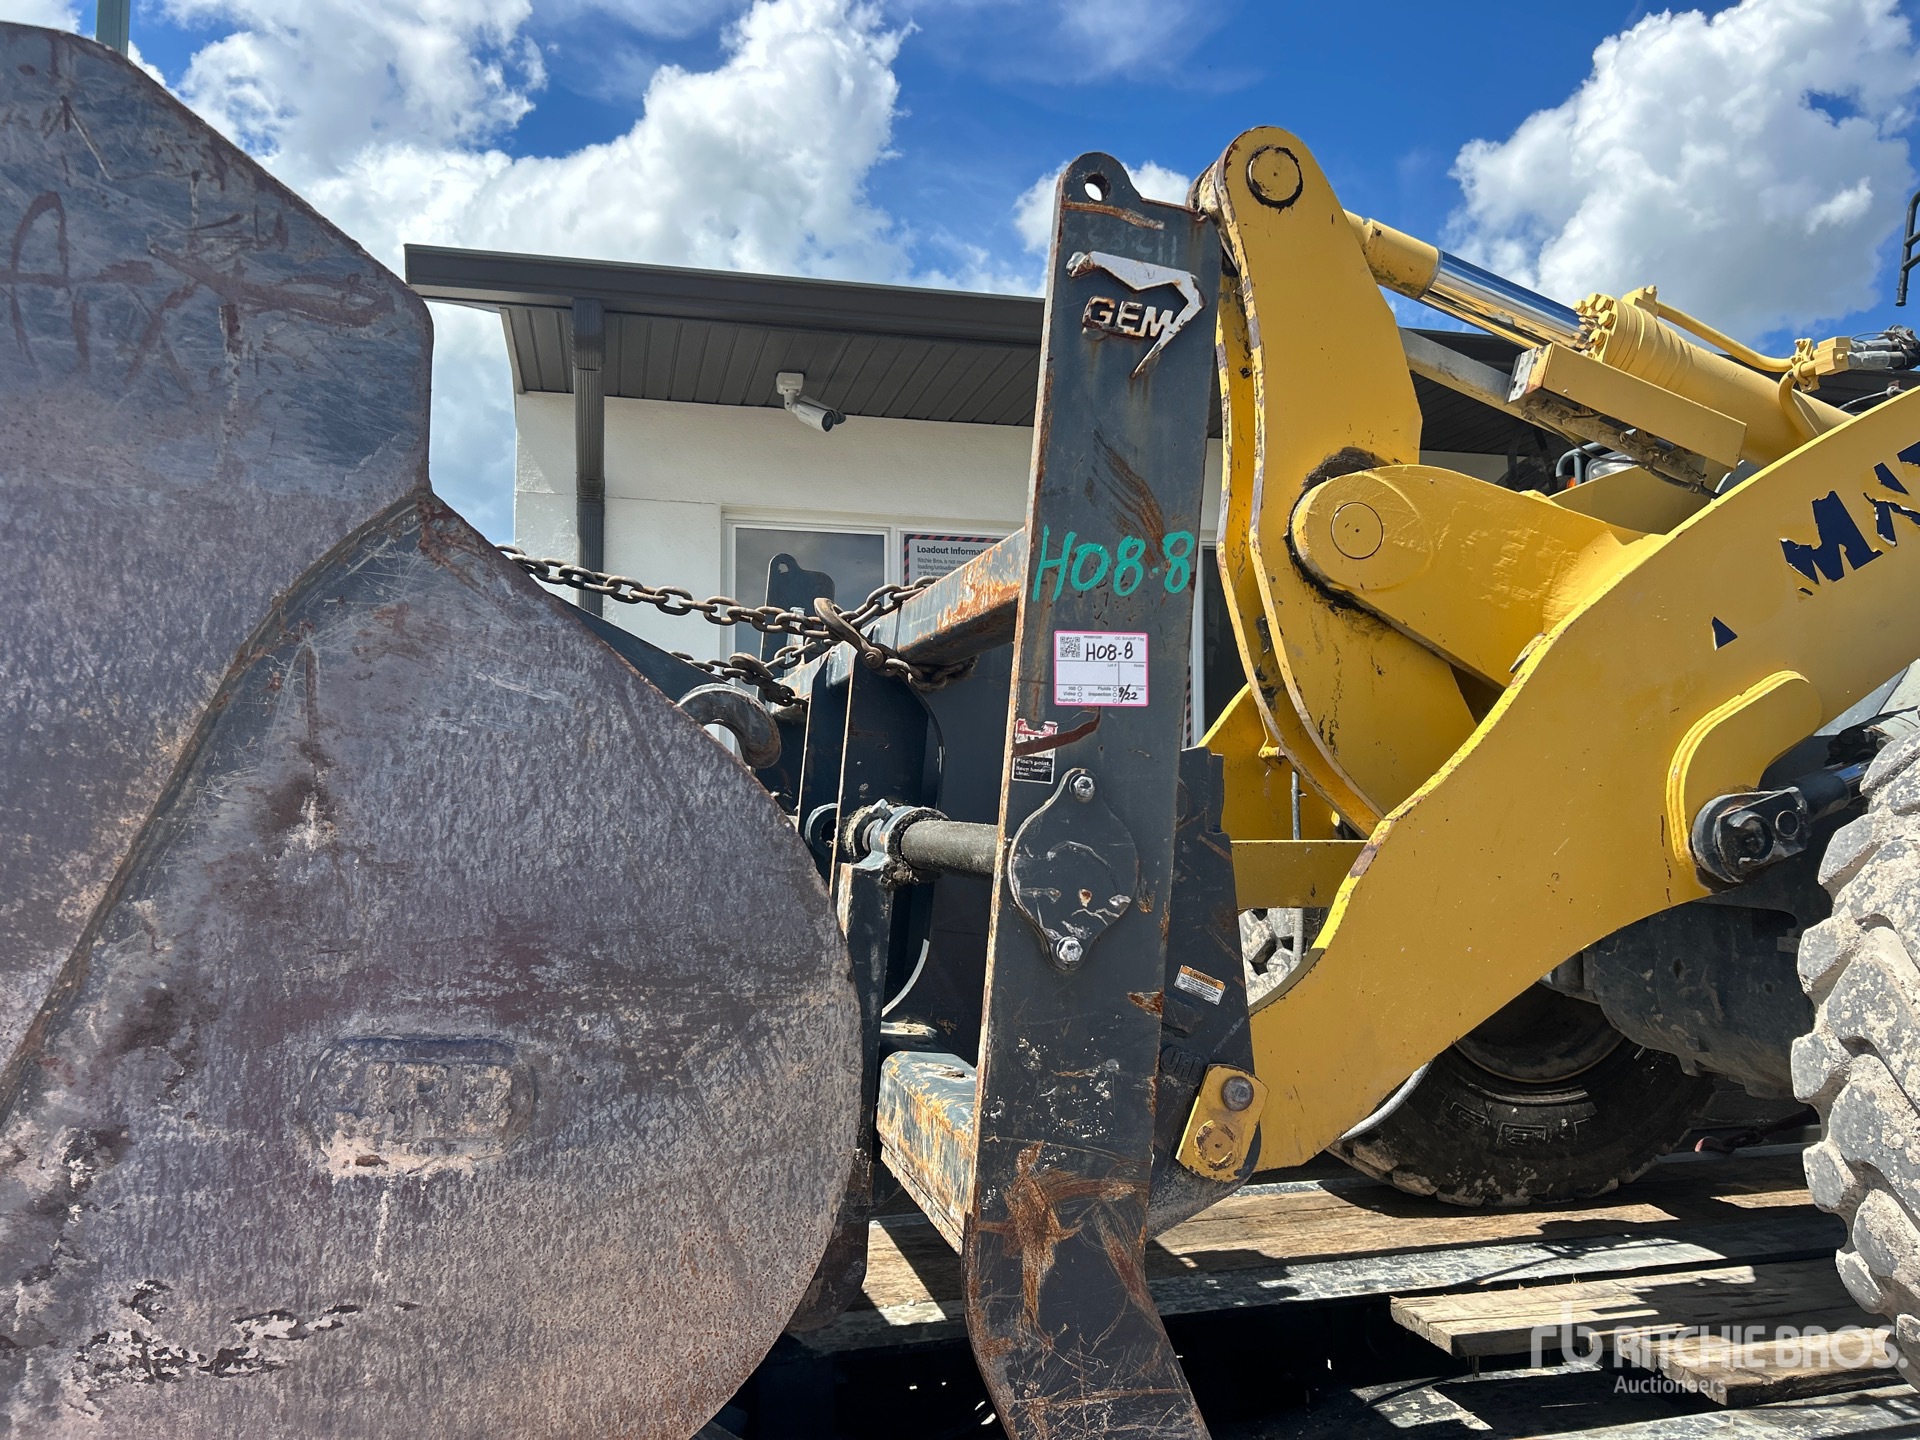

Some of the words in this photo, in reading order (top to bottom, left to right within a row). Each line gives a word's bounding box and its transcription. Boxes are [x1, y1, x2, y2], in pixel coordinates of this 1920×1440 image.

[1082, 295, 1177, 338] GEM
[917, 546, 949, 554] Loadout
[951, 547, 986, 555] Informat
[1085, 641, 1134, 662] H08-8
[1193, 972, 1218, 987] WARNING
